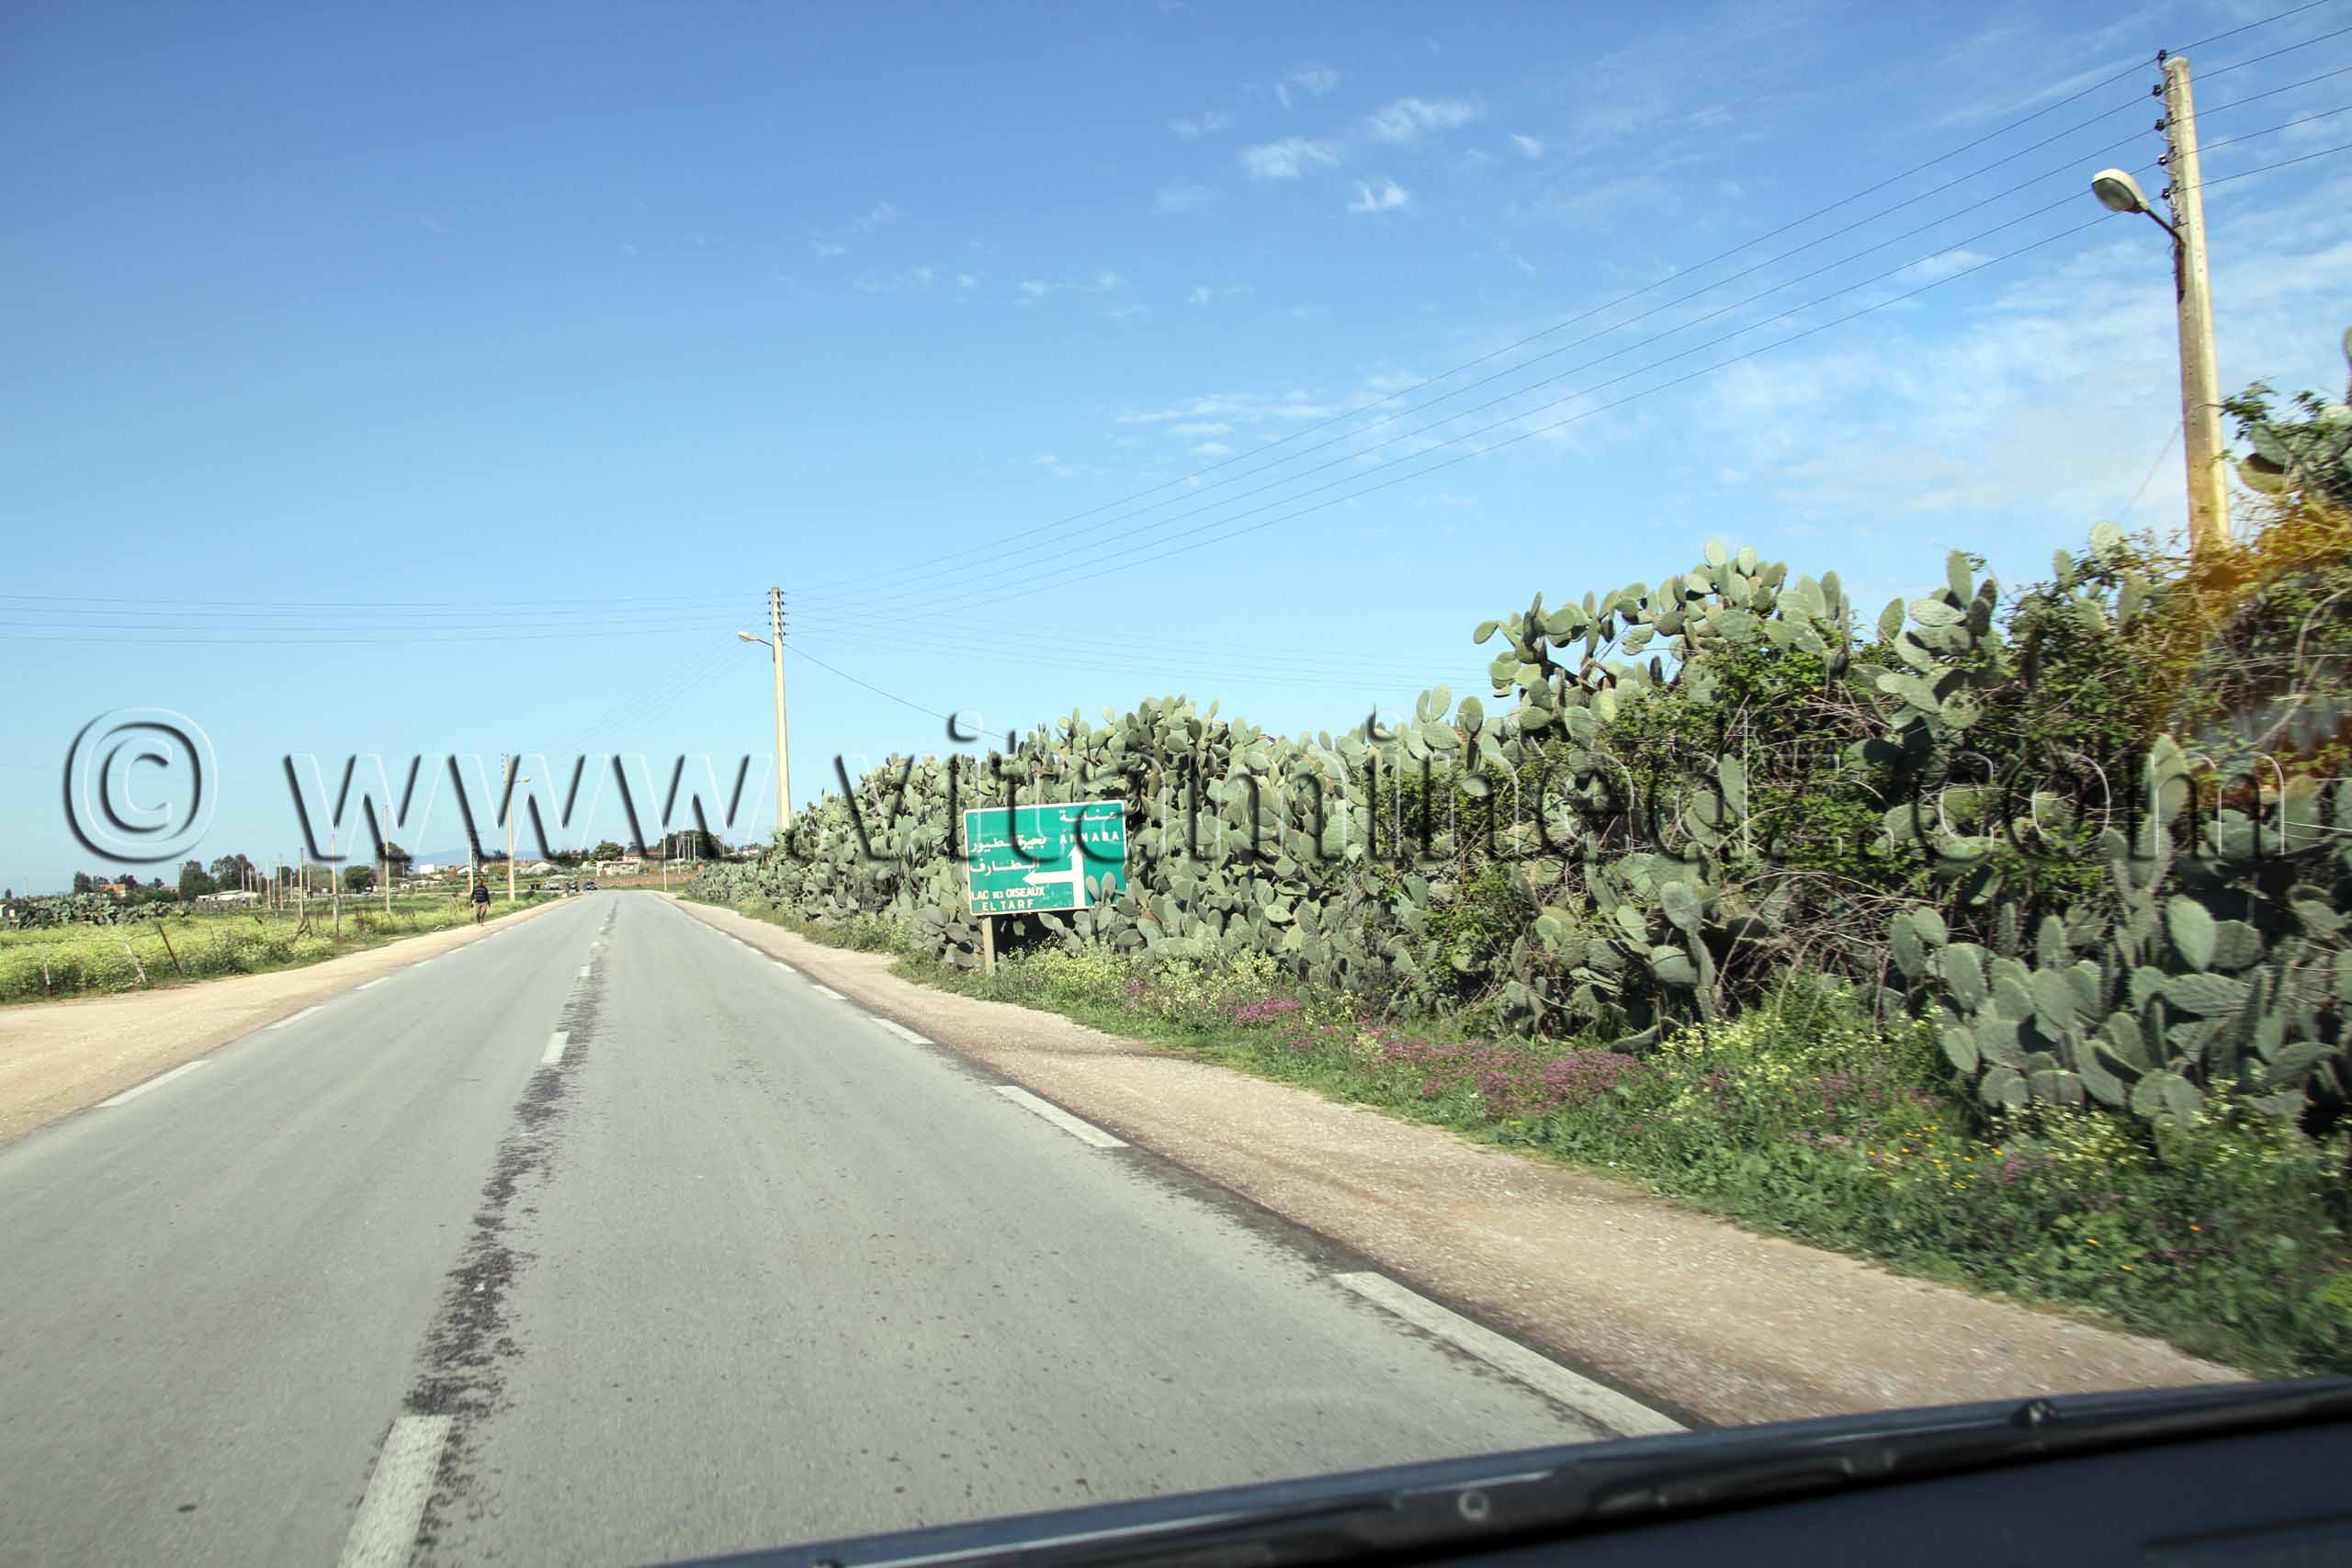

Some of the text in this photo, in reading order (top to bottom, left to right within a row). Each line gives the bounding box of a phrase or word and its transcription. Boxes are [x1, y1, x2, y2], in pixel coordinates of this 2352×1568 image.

[971, 889, 989, 901] LAC
[1006, 887, 1046, 898] OISEAUX
[982, 898, 1034, 911] EL TARF
